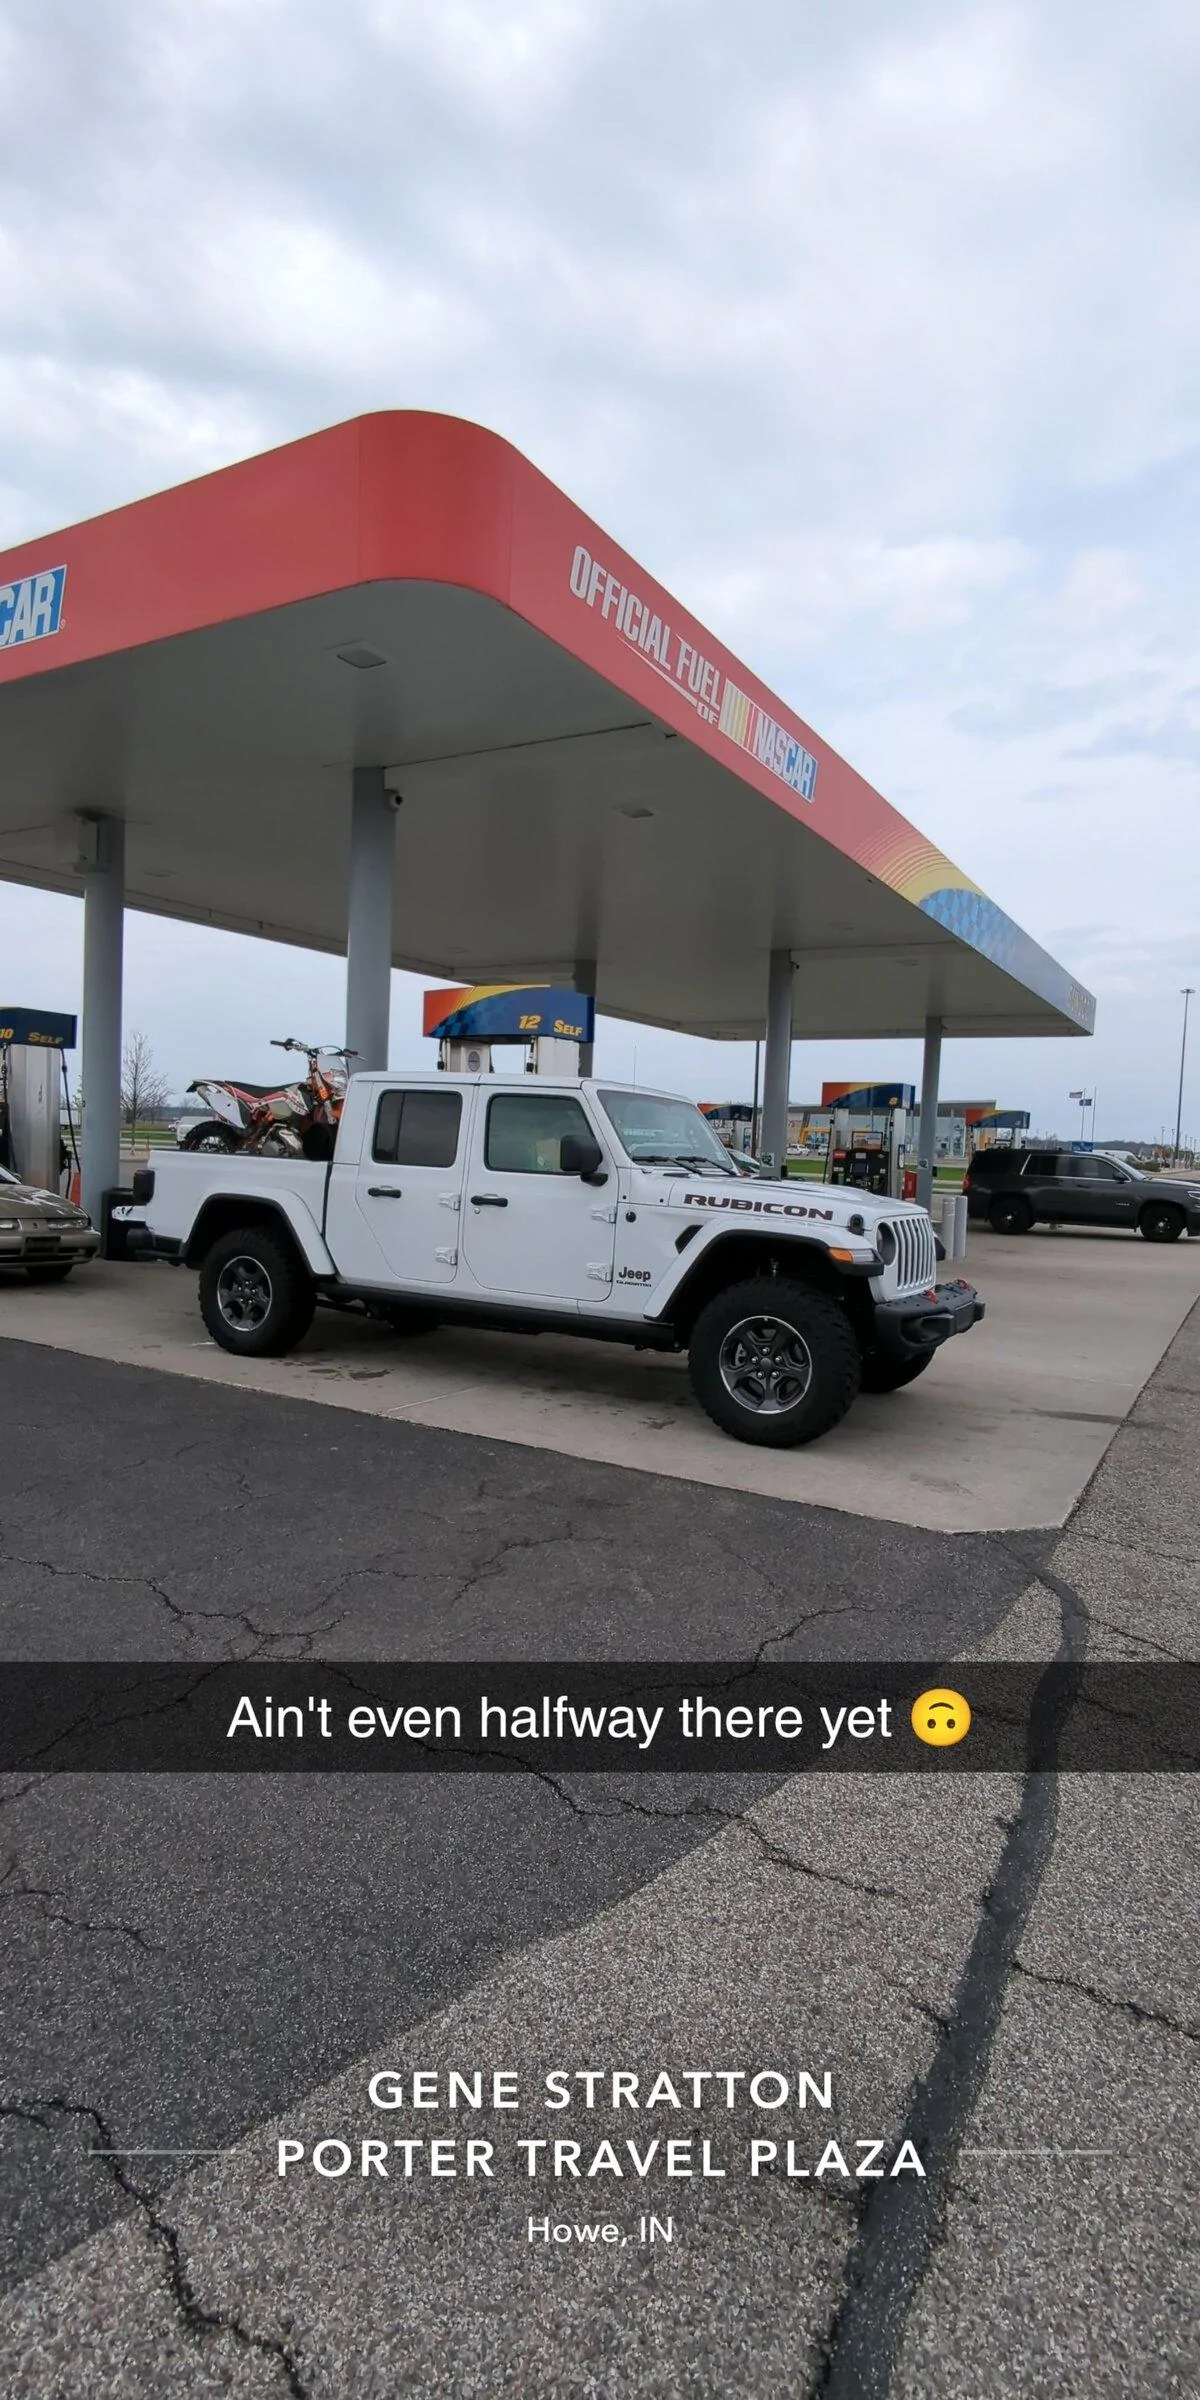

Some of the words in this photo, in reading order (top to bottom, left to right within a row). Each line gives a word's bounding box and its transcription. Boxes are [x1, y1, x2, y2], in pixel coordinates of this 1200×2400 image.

[569, 545, 671, 671] OFFICIAL
[677, 638, 720, 711] FUEL
[696, 701, 719, 724] OF
[752, 711, 813, 799] NASCAR
[519, 1014, 541, 1029] 12
[683, 1193, 834, 1221] RUBICON
[618, 1266, 651, 1282] Jeep
